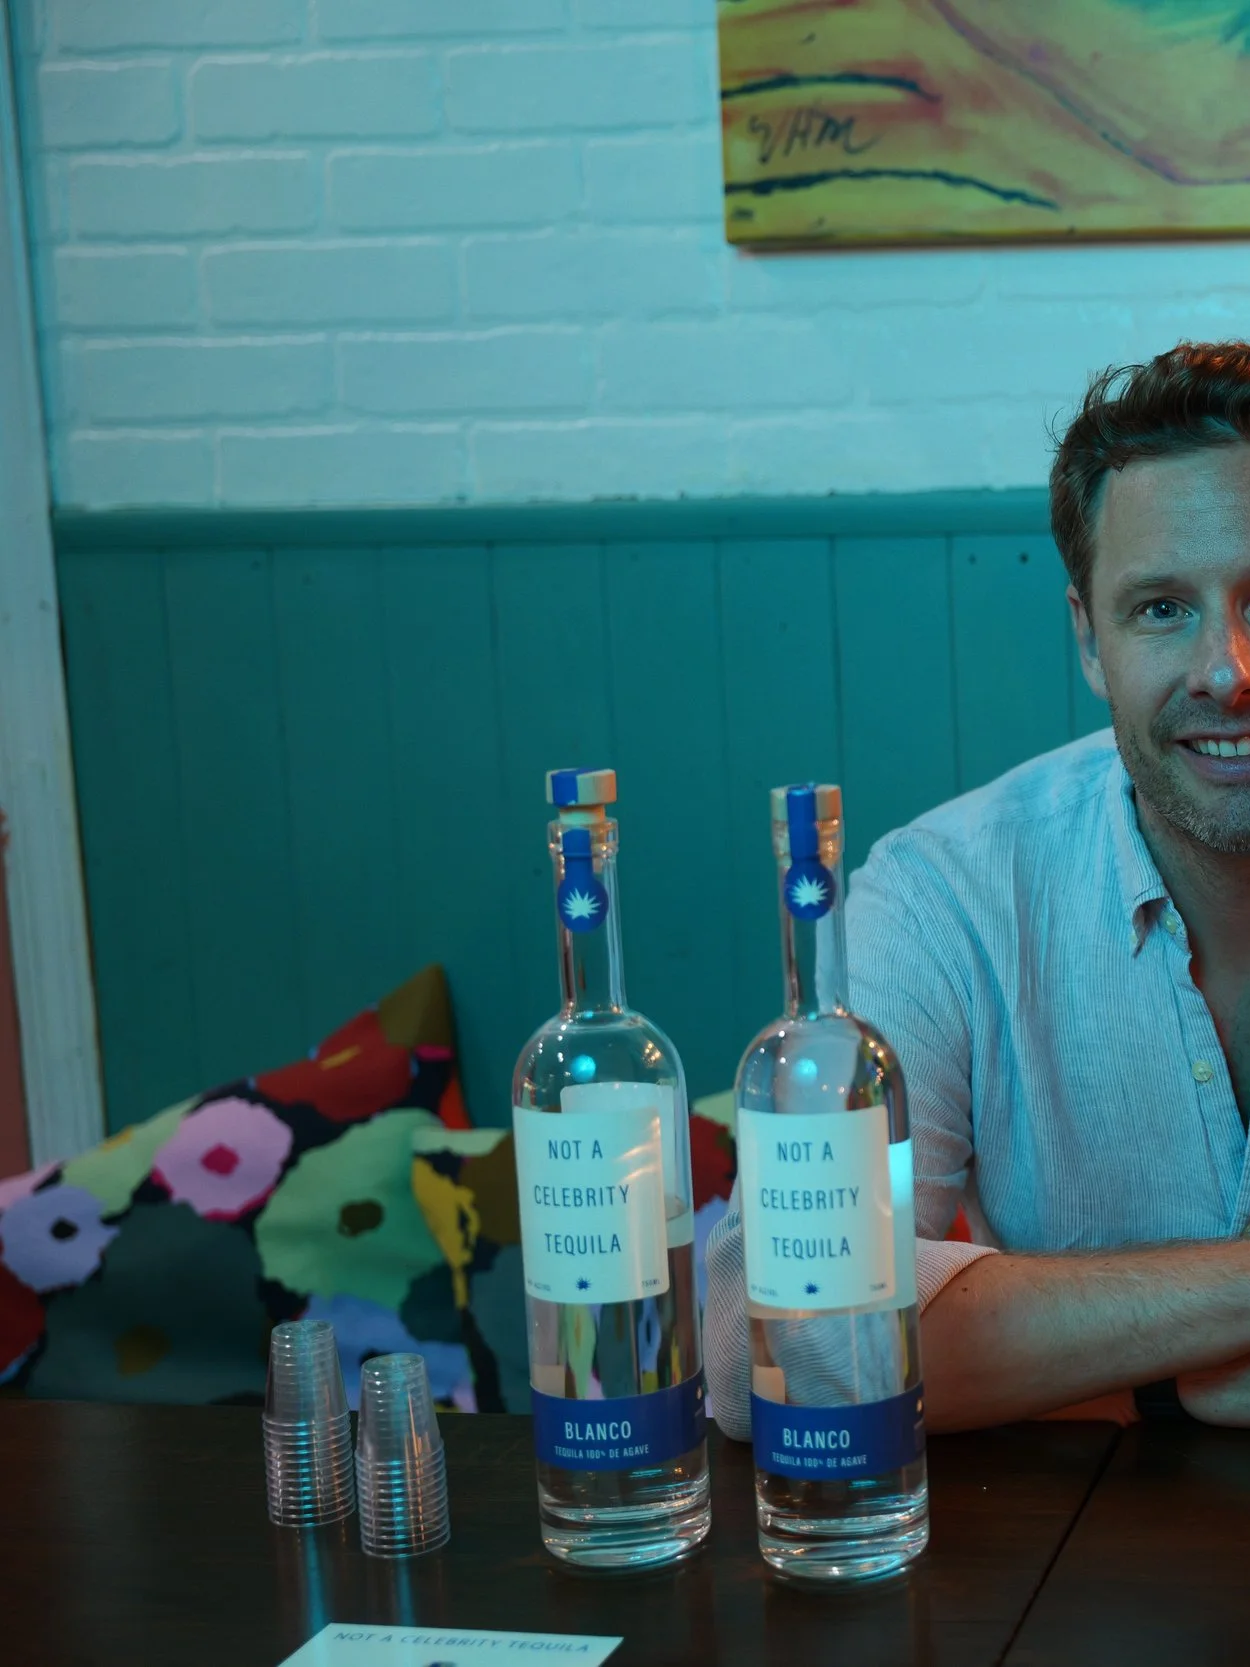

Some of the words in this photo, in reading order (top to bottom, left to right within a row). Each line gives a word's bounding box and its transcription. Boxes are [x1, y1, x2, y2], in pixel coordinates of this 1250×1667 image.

[548, 1139, 582, 1160] NOT
[591, 1139, 603, 1159] A
[777, 1141, 813, 1162] NOT
[822, 1141, 834, 1161] A
[533, 1184, 630, 1208] CELEBRITY
[760, 1186, 860, 1211] CELEBRITY
[544, 1233, 621, 1256] TEQUILA
[771, 1236, 852, 1260] TEQUILA
[564, 1420, 632, 1441] BLANCO
[782, 1427, 851, 1449] BLANCO
[554, 1445, 584, 1459] TEQUILA
[609, 1448, 620, 1459] DE
[623, 1444, 650, 1457] AGAVE
[771, 1451, 801, 1467] TEQUILA
[826, 1457, 838, 1468] DE
[840, 1454, 868, 1468] AGAVE
[333, 1632, 377, 1642] NOT
[380, 1634, 394, 1642] A
[400, 1634, 502, 1649] CELEBRITY
[508, 1639, 590, 1653] TEQUILA
